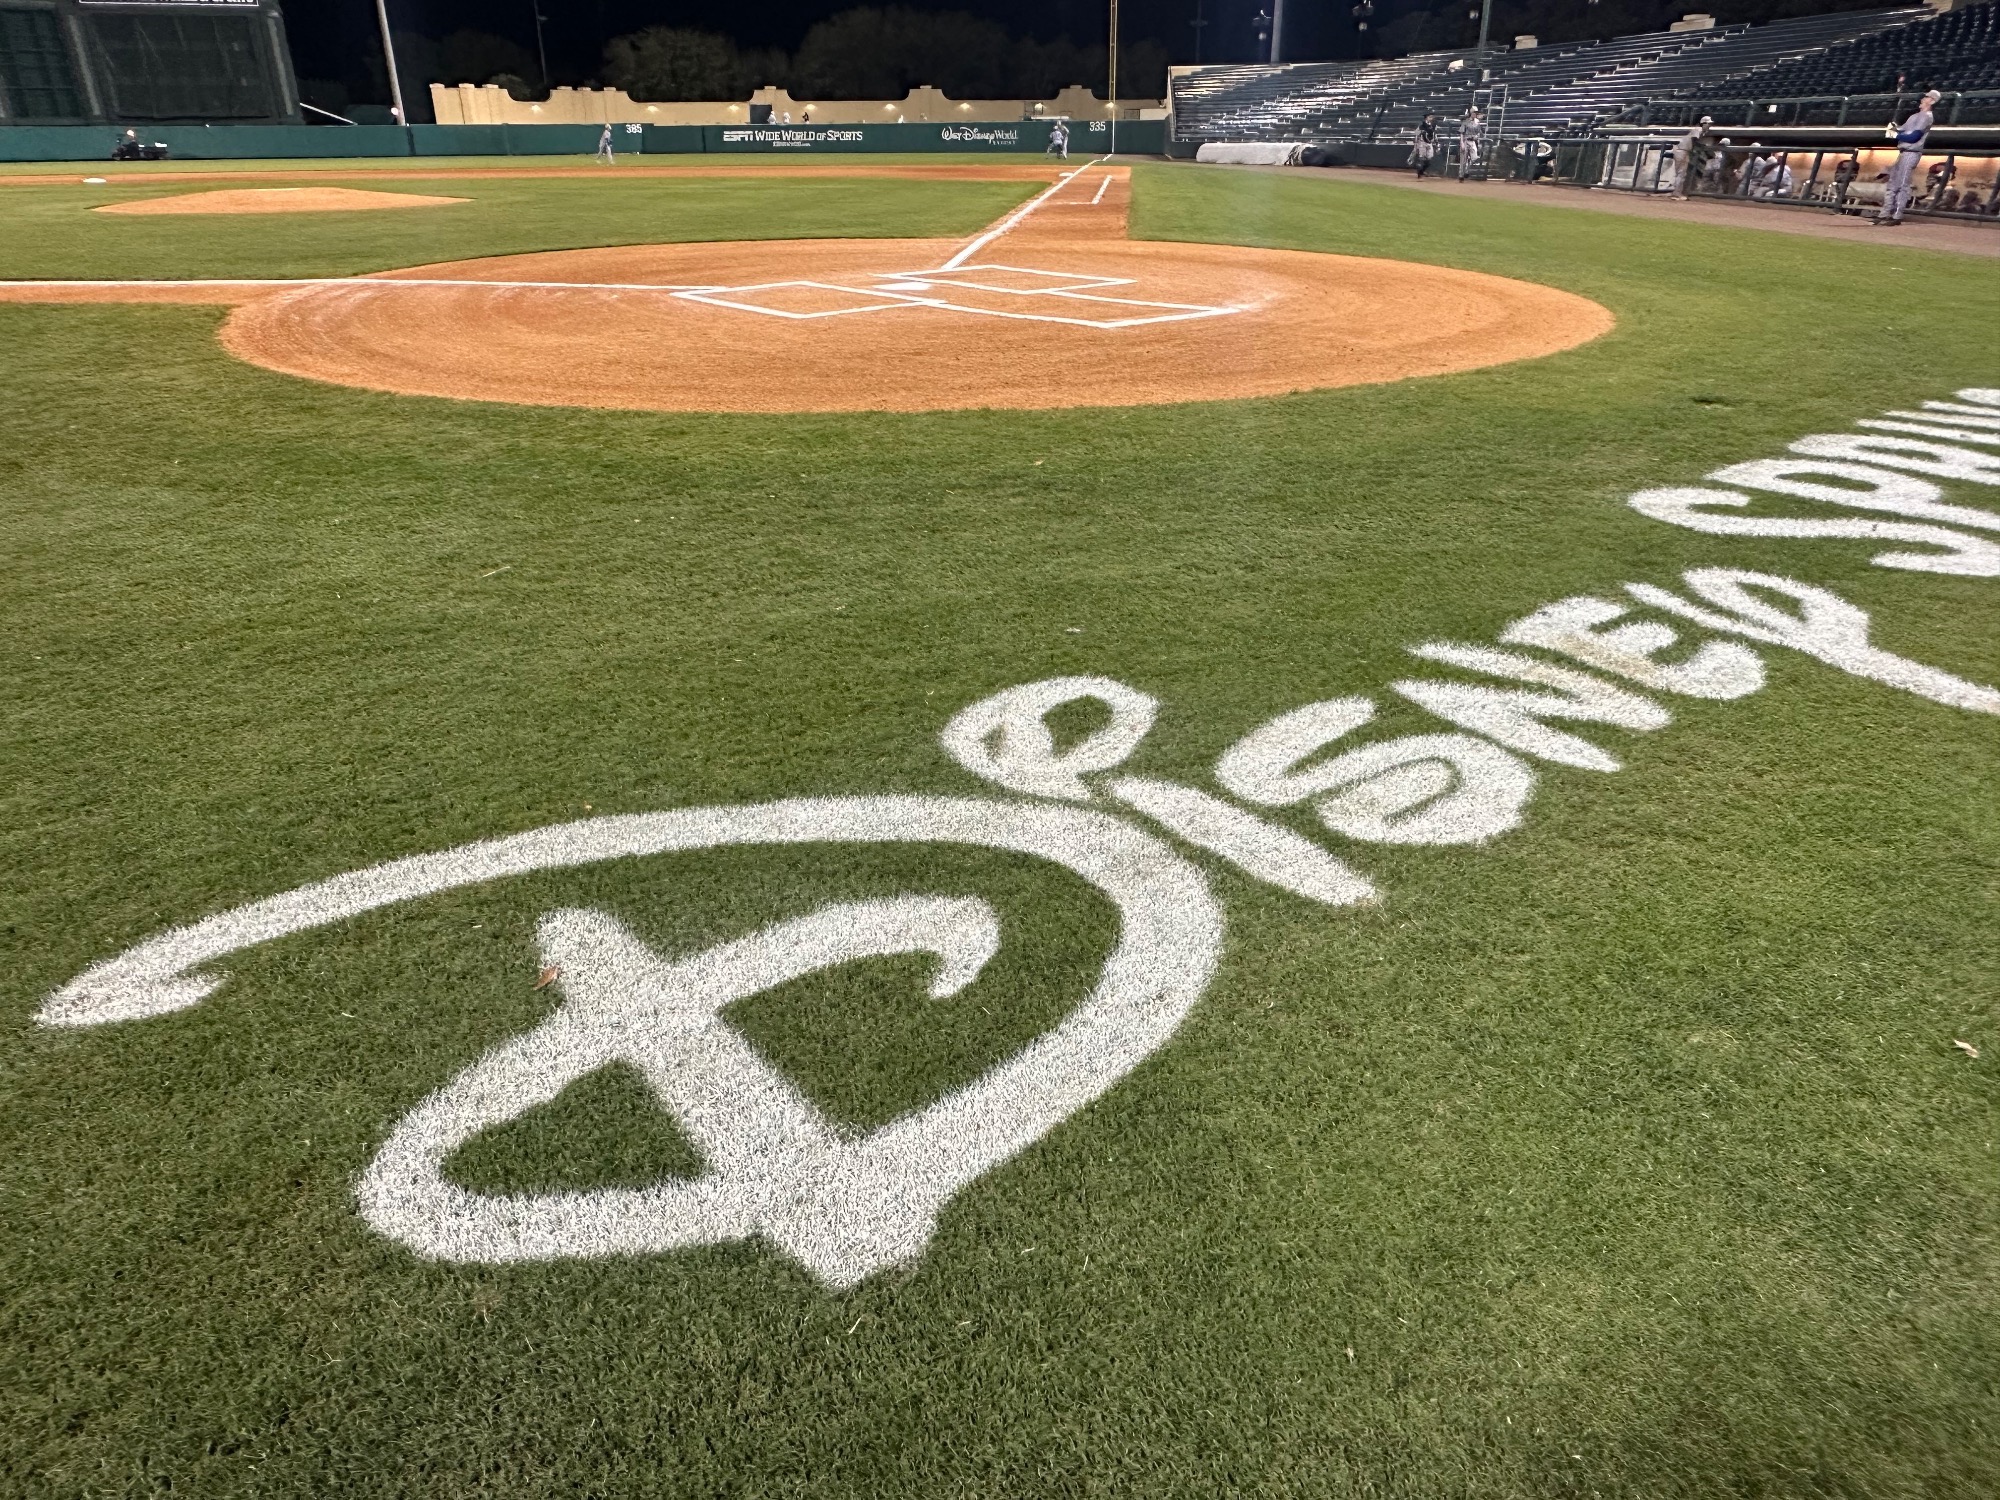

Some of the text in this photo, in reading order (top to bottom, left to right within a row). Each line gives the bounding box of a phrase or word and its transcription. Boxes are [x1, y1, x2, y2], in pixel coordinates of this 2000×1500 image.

[625, 124, 642, 134] 385
[723, 131, 753, 141] ESPN
[754, 130, 780, 141] WIDE
[781, 130, 815, 141] WORLD
[827, 130, 863, 141] SPORTS
